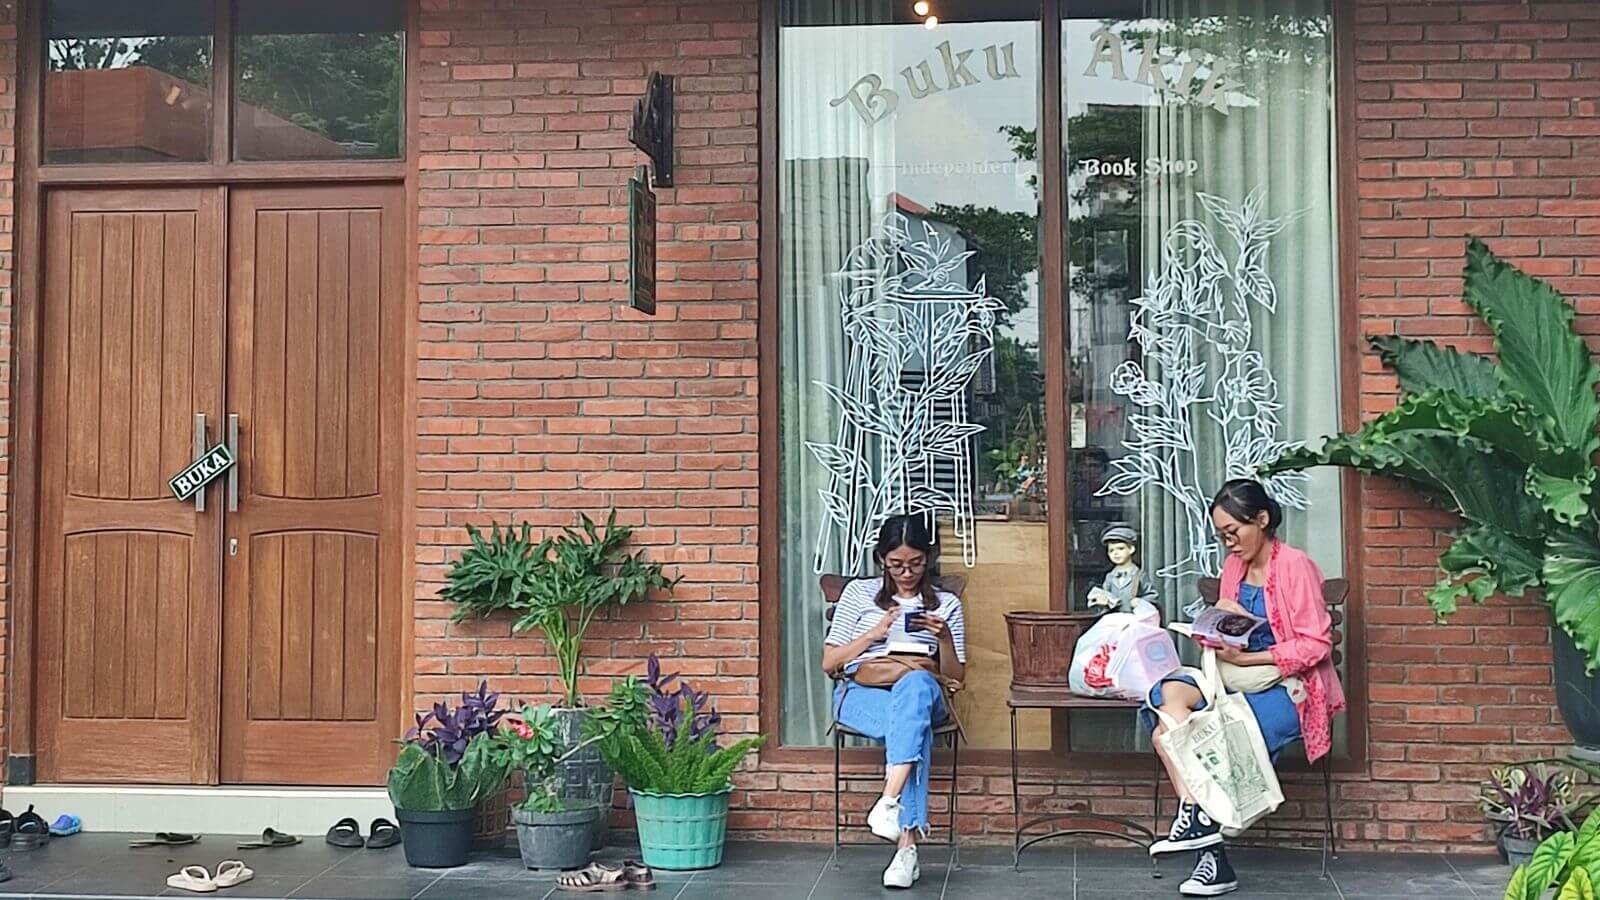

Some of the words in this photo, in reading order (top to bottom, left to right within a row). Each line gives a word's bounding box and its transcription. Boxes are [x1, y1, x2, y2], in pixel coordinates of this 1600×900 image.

[830, 40, 1021, 127] Buku
[902, 159, 1023, 177] Independen
[1079, 157, 1136, 176] Book
[1145, 156, 1198, 176] Shop
[174, 452, 228, 495] BUKA
